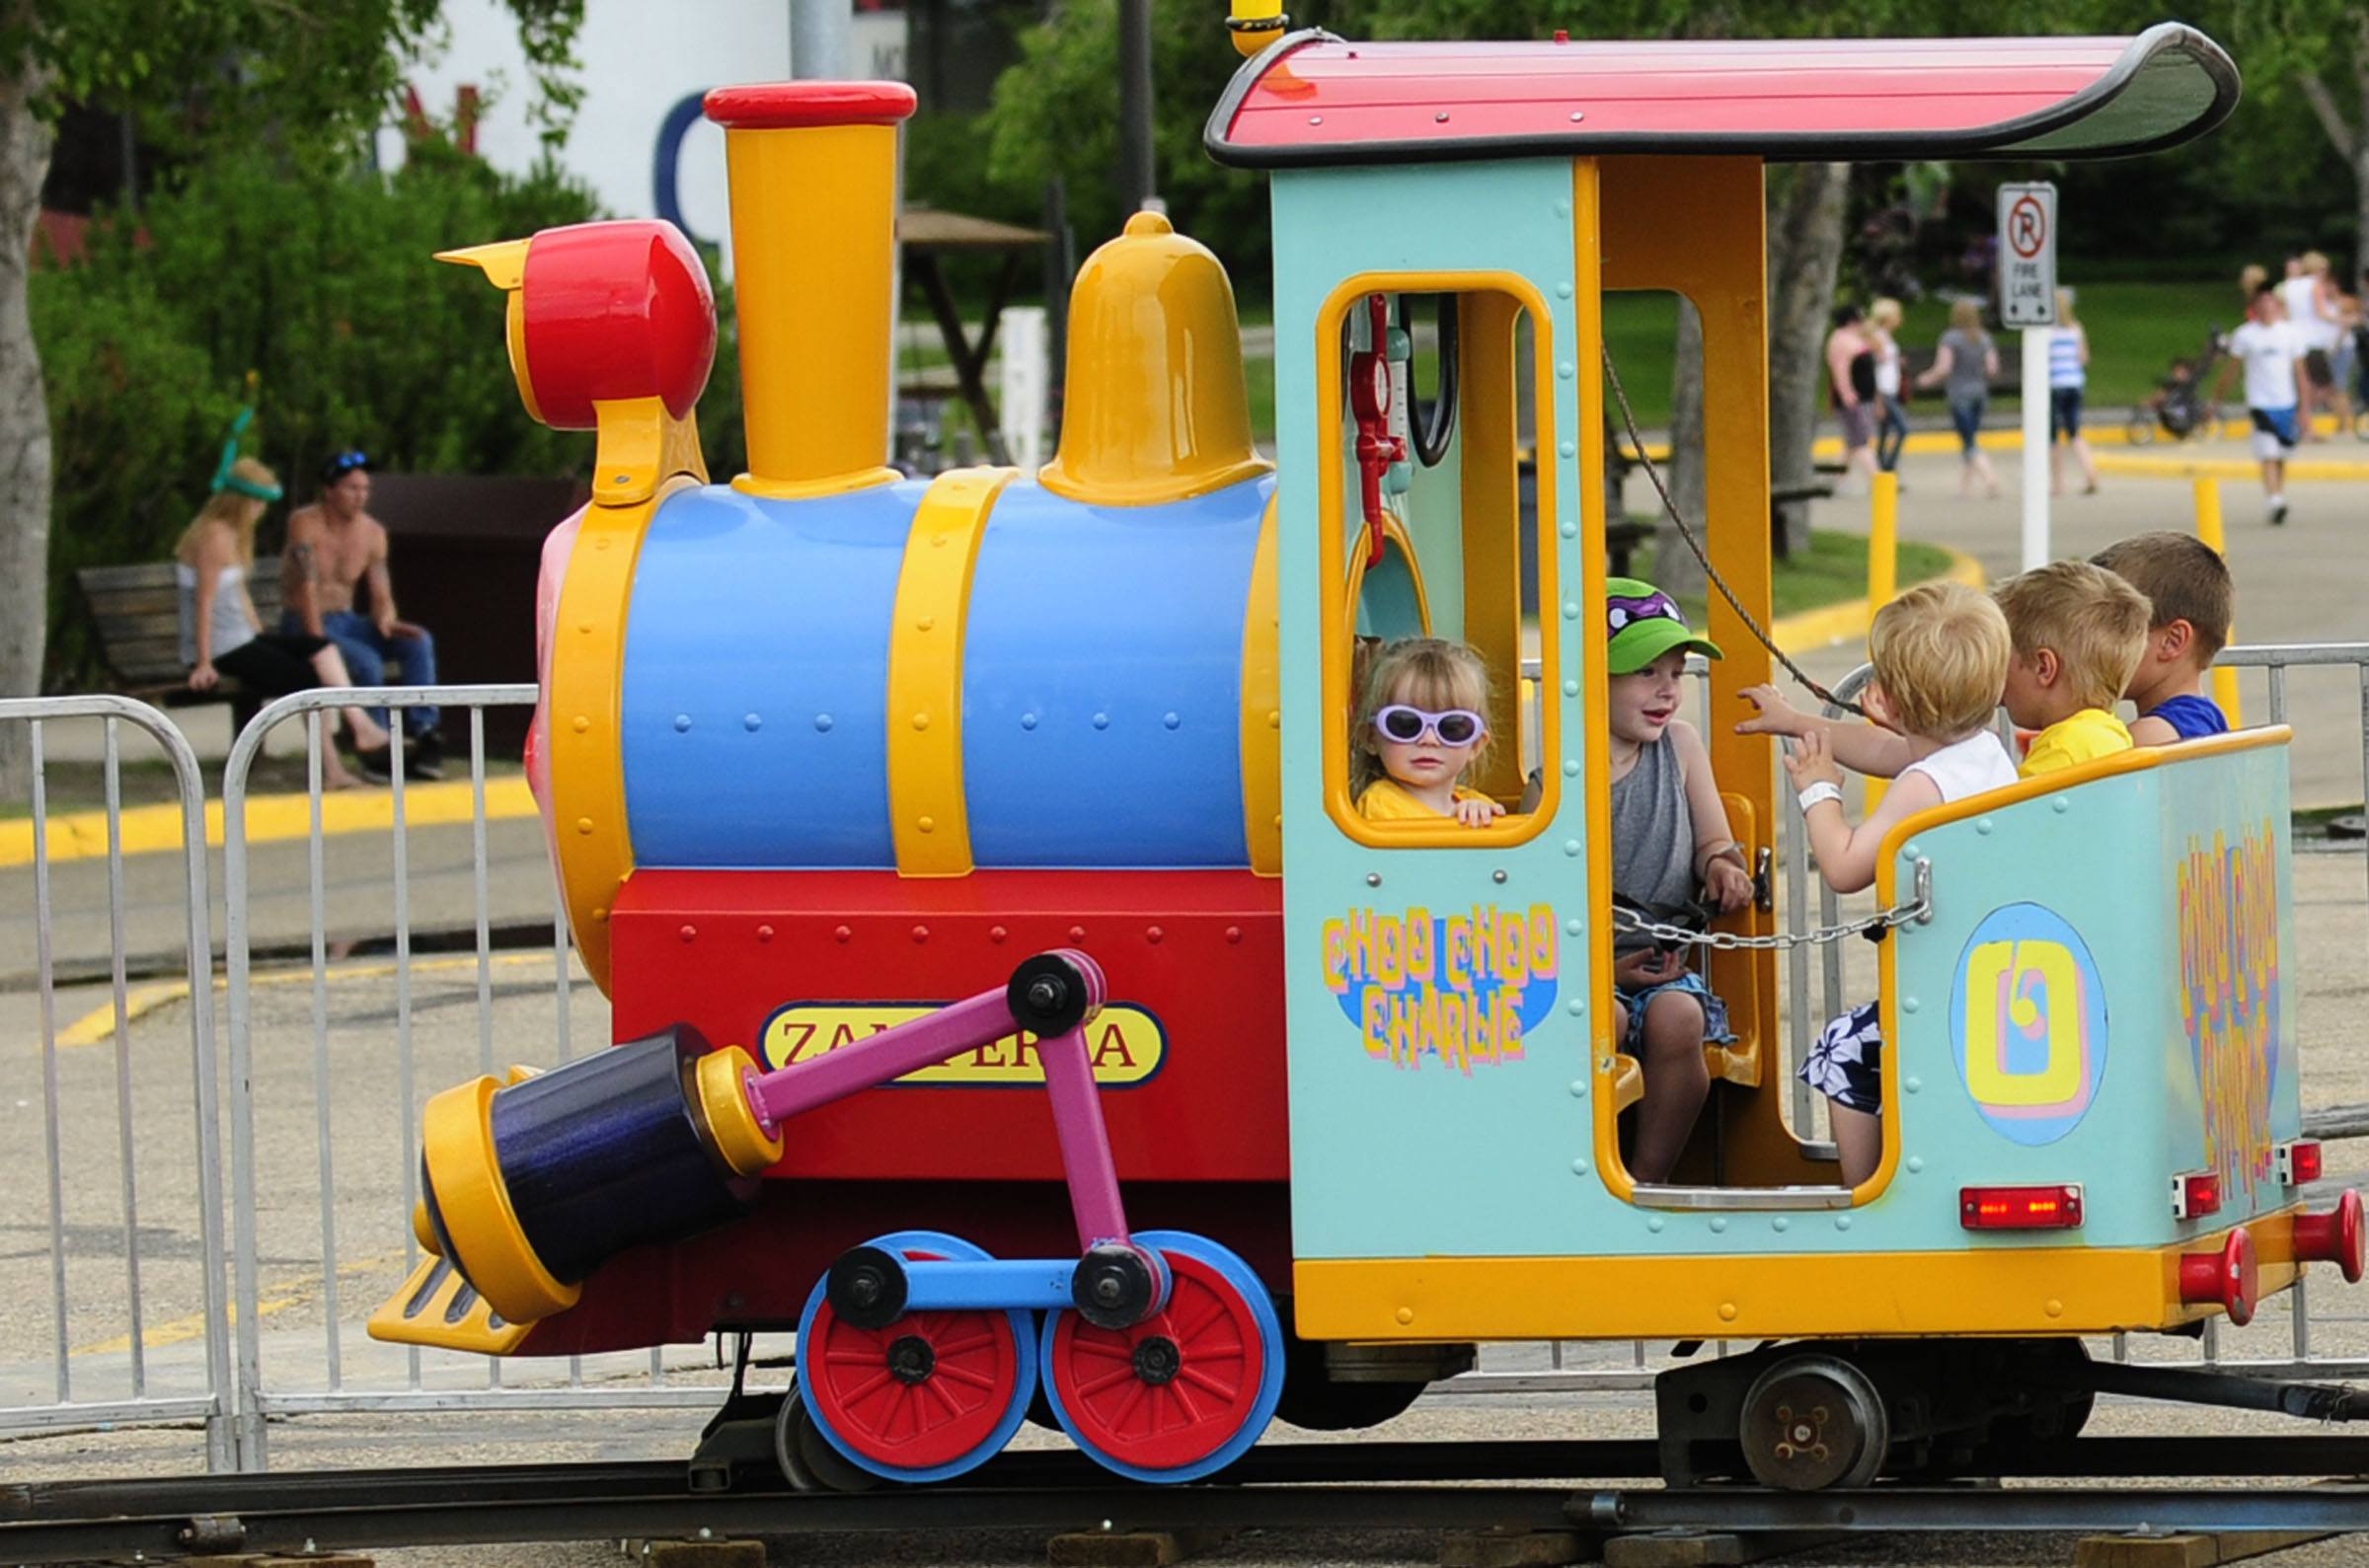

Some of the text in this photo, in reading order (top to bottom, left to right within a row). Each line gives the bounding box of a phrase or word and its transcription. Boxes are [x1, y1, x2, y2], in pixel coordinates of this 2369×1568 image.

[2012, 281, 2042, 298] LANE
[2013, 262, 2038, 279] FIRE
[1322, 902, 1560, 995] CHOO CHOO
[1361, 981, 1525, 1078] CHARLIE
